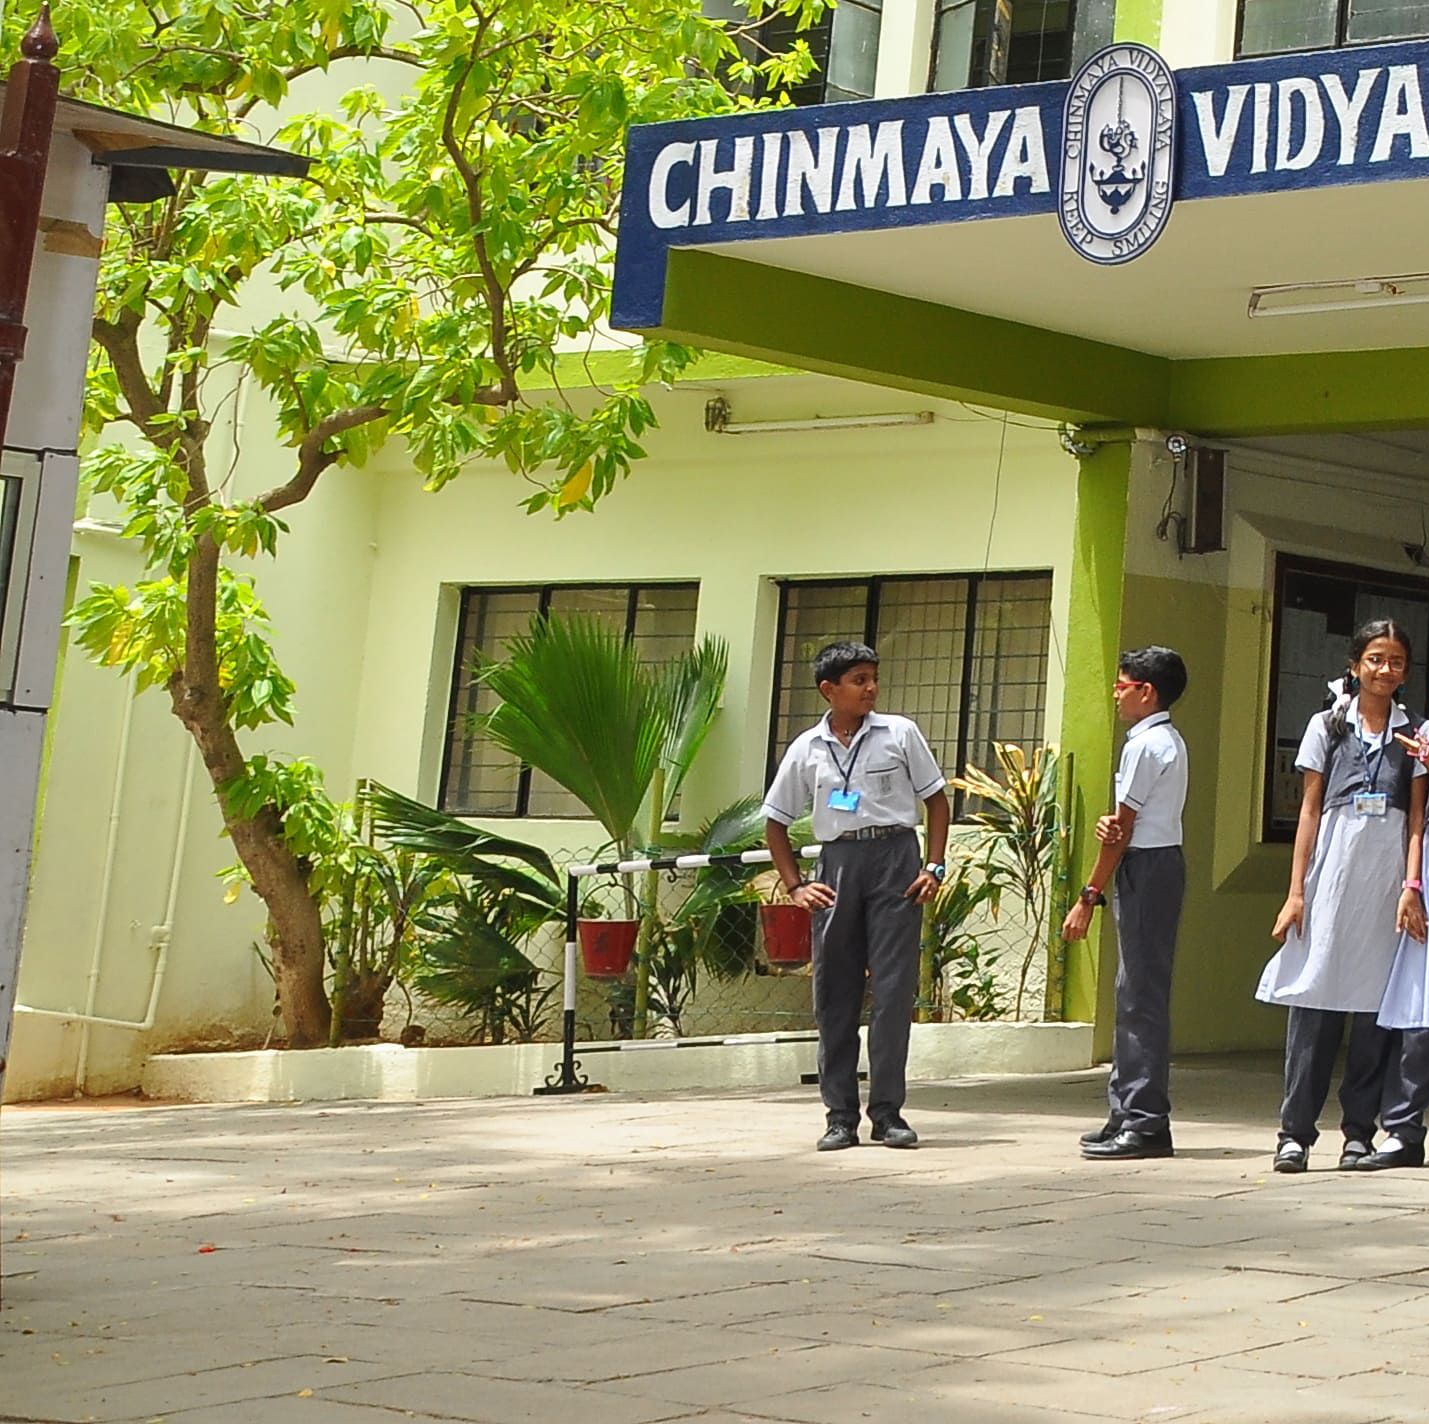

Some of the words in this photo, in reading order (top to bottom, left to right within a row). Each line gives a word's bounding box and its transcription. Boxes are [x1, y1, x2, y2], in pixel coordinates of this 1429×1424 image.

[1065, 54, 1120, 160] CHINMAYA
[1127, 49, 1173, 152] VIDYALAYA
[647, 104, 1052, 229] CHINMAYA
[1063, 190, 1095, 246] KEEP
[1111, 180, 1169, 257] SMILING
